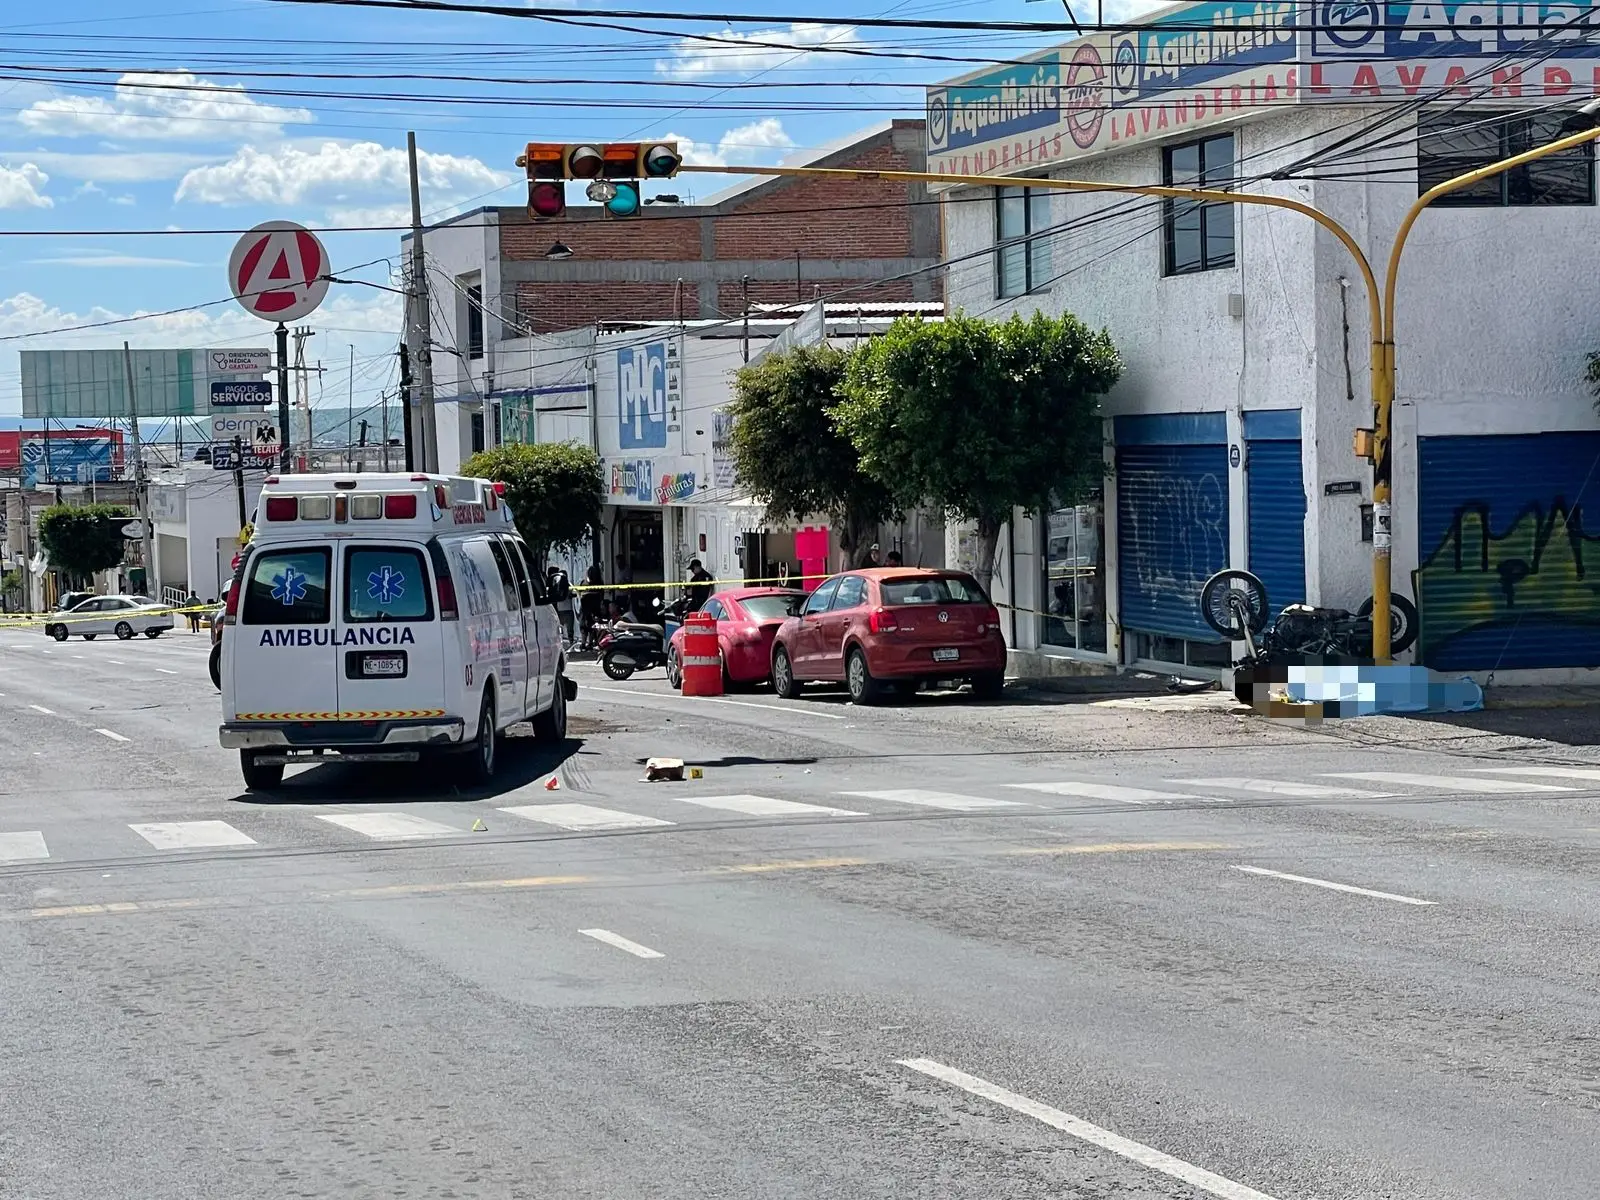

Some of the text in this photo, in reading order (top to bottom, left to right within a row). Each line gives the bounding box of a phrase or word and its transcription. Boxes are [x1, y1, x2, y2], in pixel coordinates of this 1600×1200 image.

[1143, 3, 1293, 83] AquaMatic
[951, 66, 1057, 138] AquaMatic
[1111, 69, 1297, 141] LAVANDERIAS
[212, 392, 271, 402] SERVICIOS
[225, 385, 258, 393] PAGO DE
[620, 345, 663, 440] PPG
[252, 445, 280, 454] TECATE
[655, 476, 693, 504] Pinturas
[259, 626, 415, 646] AMBULANCIA
[465, 664, 473, 686] 03
